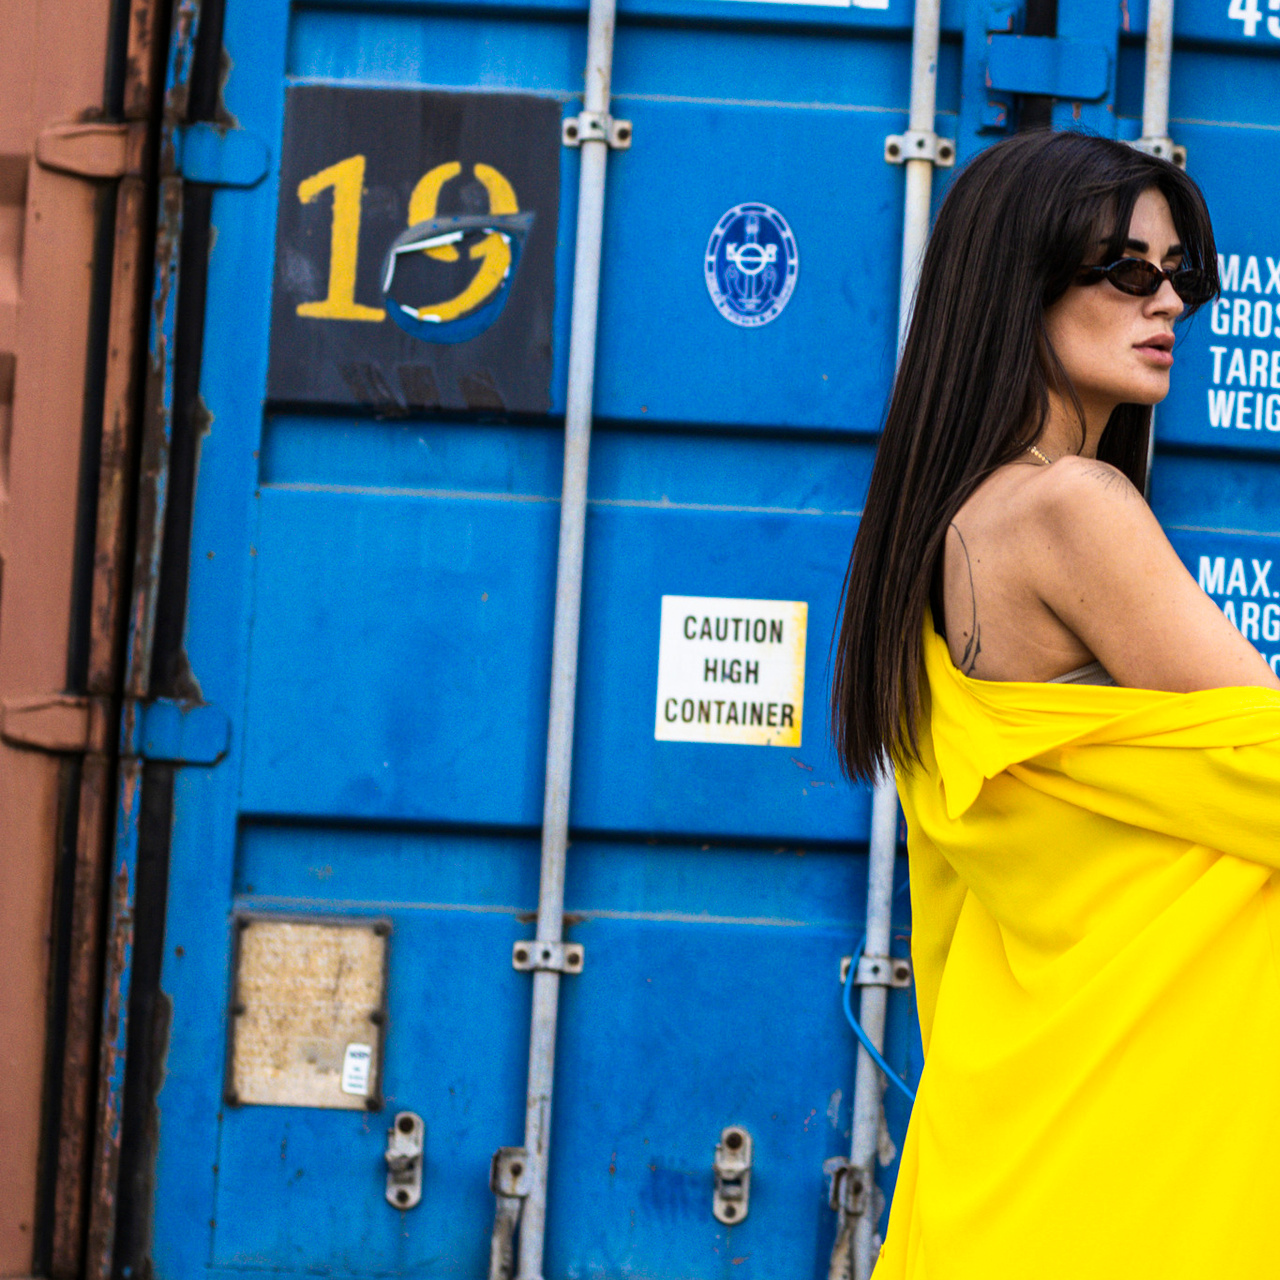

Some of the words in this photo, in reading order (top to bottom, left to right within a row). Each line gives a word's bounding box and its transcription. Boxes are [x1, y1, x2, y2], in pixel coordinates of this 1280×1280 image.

[1199, 555, 1280, 598] MAX.
[683, 615, 784, 644] CAUTION
[704, 657, 760, 684] HIGH
[664, 698, 796, 728] CONTAINER
